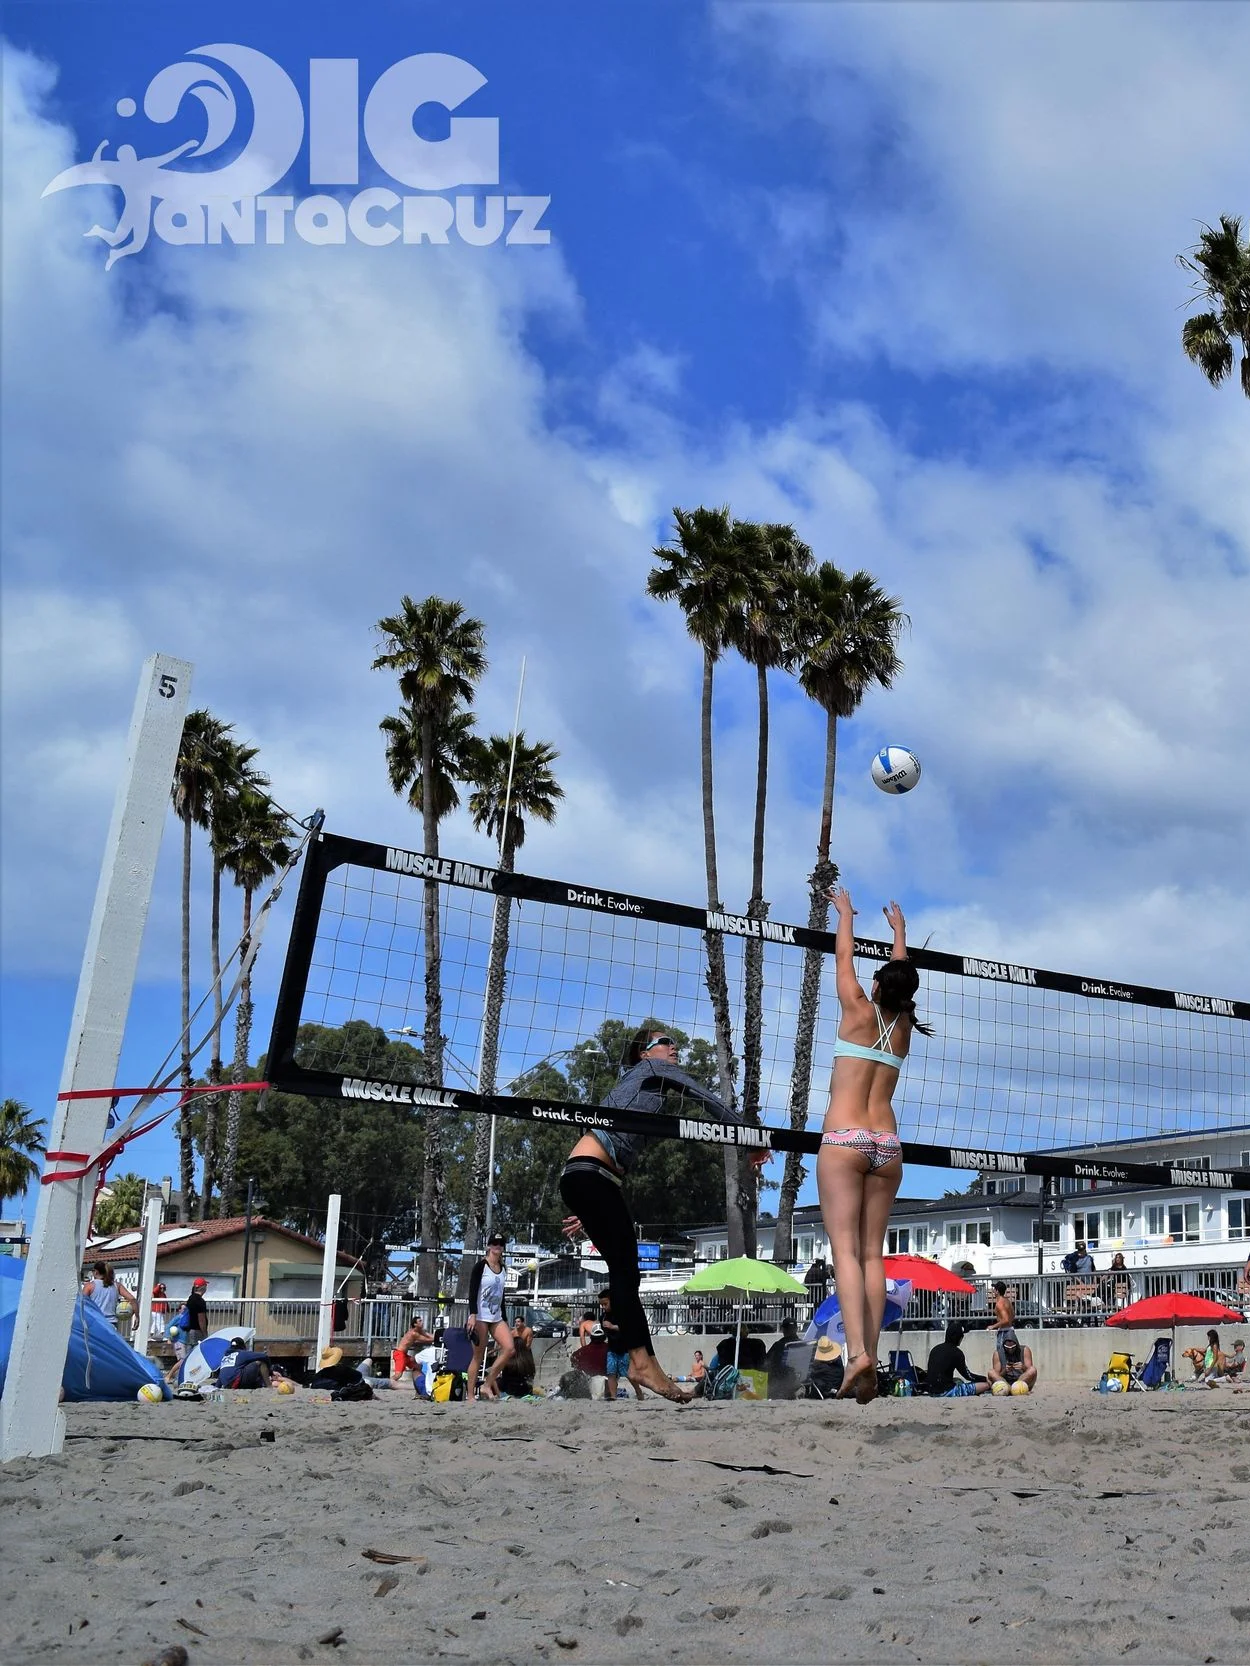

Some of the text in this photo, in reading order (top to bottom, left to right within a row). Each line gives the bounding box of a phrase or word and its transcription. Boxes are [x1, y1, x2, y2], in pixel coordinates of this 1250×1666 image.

[158, 674, 178, 699] 5
[386, 848, 494, 890] MUSCLE MILK
[706, 911, 795, 944] MUSCLE MILK
[963, 957, 1036, 986] MUSCLE MILK
[1175, 993, 1235, 1016] MUSCLE MILK
[341, 1077, 458, 1108] MUSCLE MILK
[679, 1119, 772, 1148] MUSCLE MILK
[950, 1150, 1025, 1173] MUSCLE MILK
[1171, 1169, 1233, 1188] MUSCLE MILK
